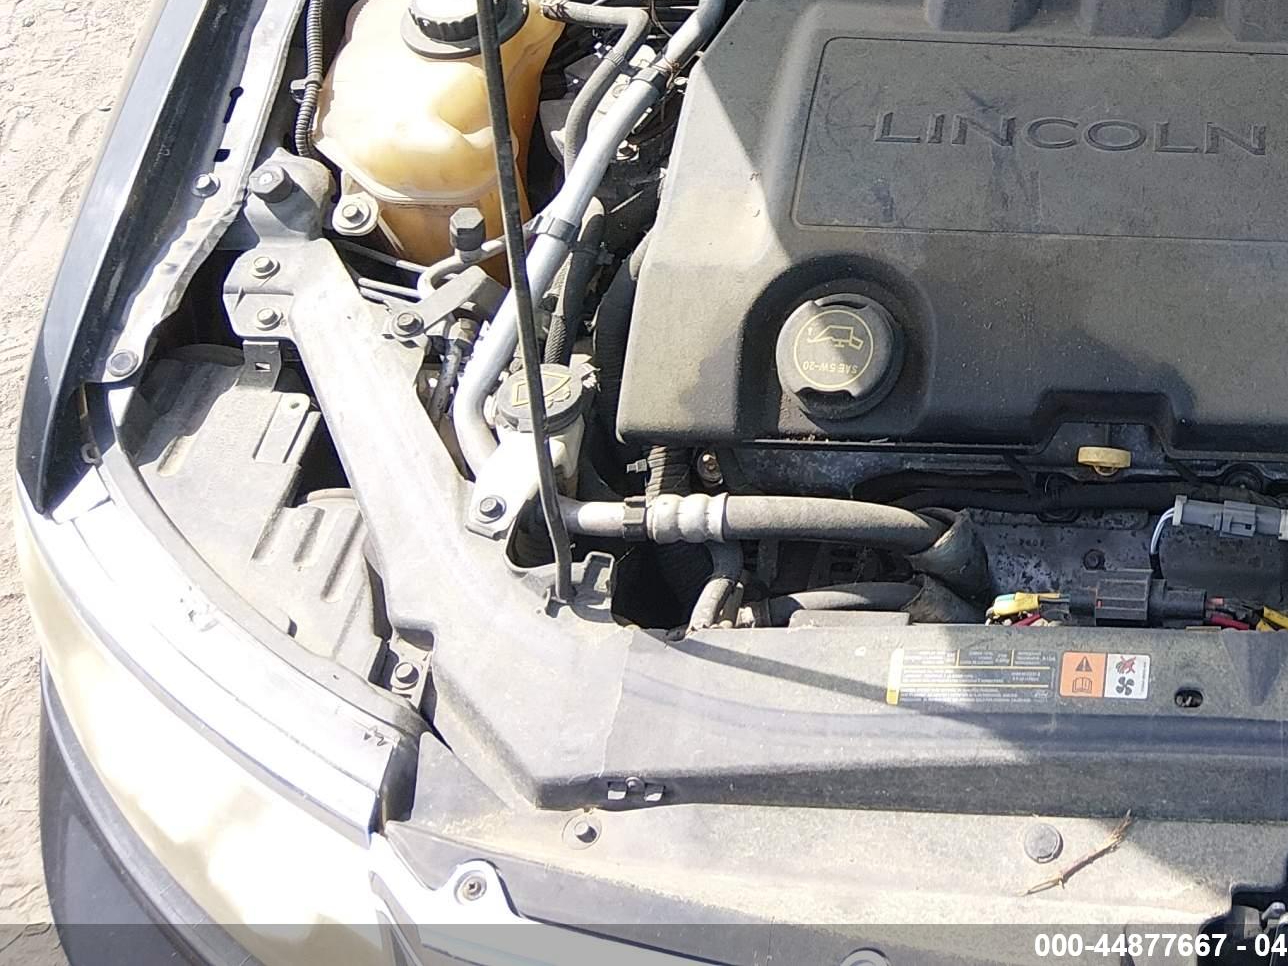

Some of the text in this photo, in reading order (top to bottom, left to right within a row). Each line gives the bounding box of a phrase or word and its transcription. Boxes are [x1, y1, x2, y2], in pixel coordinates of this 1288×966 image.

[874, 111, 1267, 157] LINCOLN
[802, 360, 859, 374] SAE 5W-20
